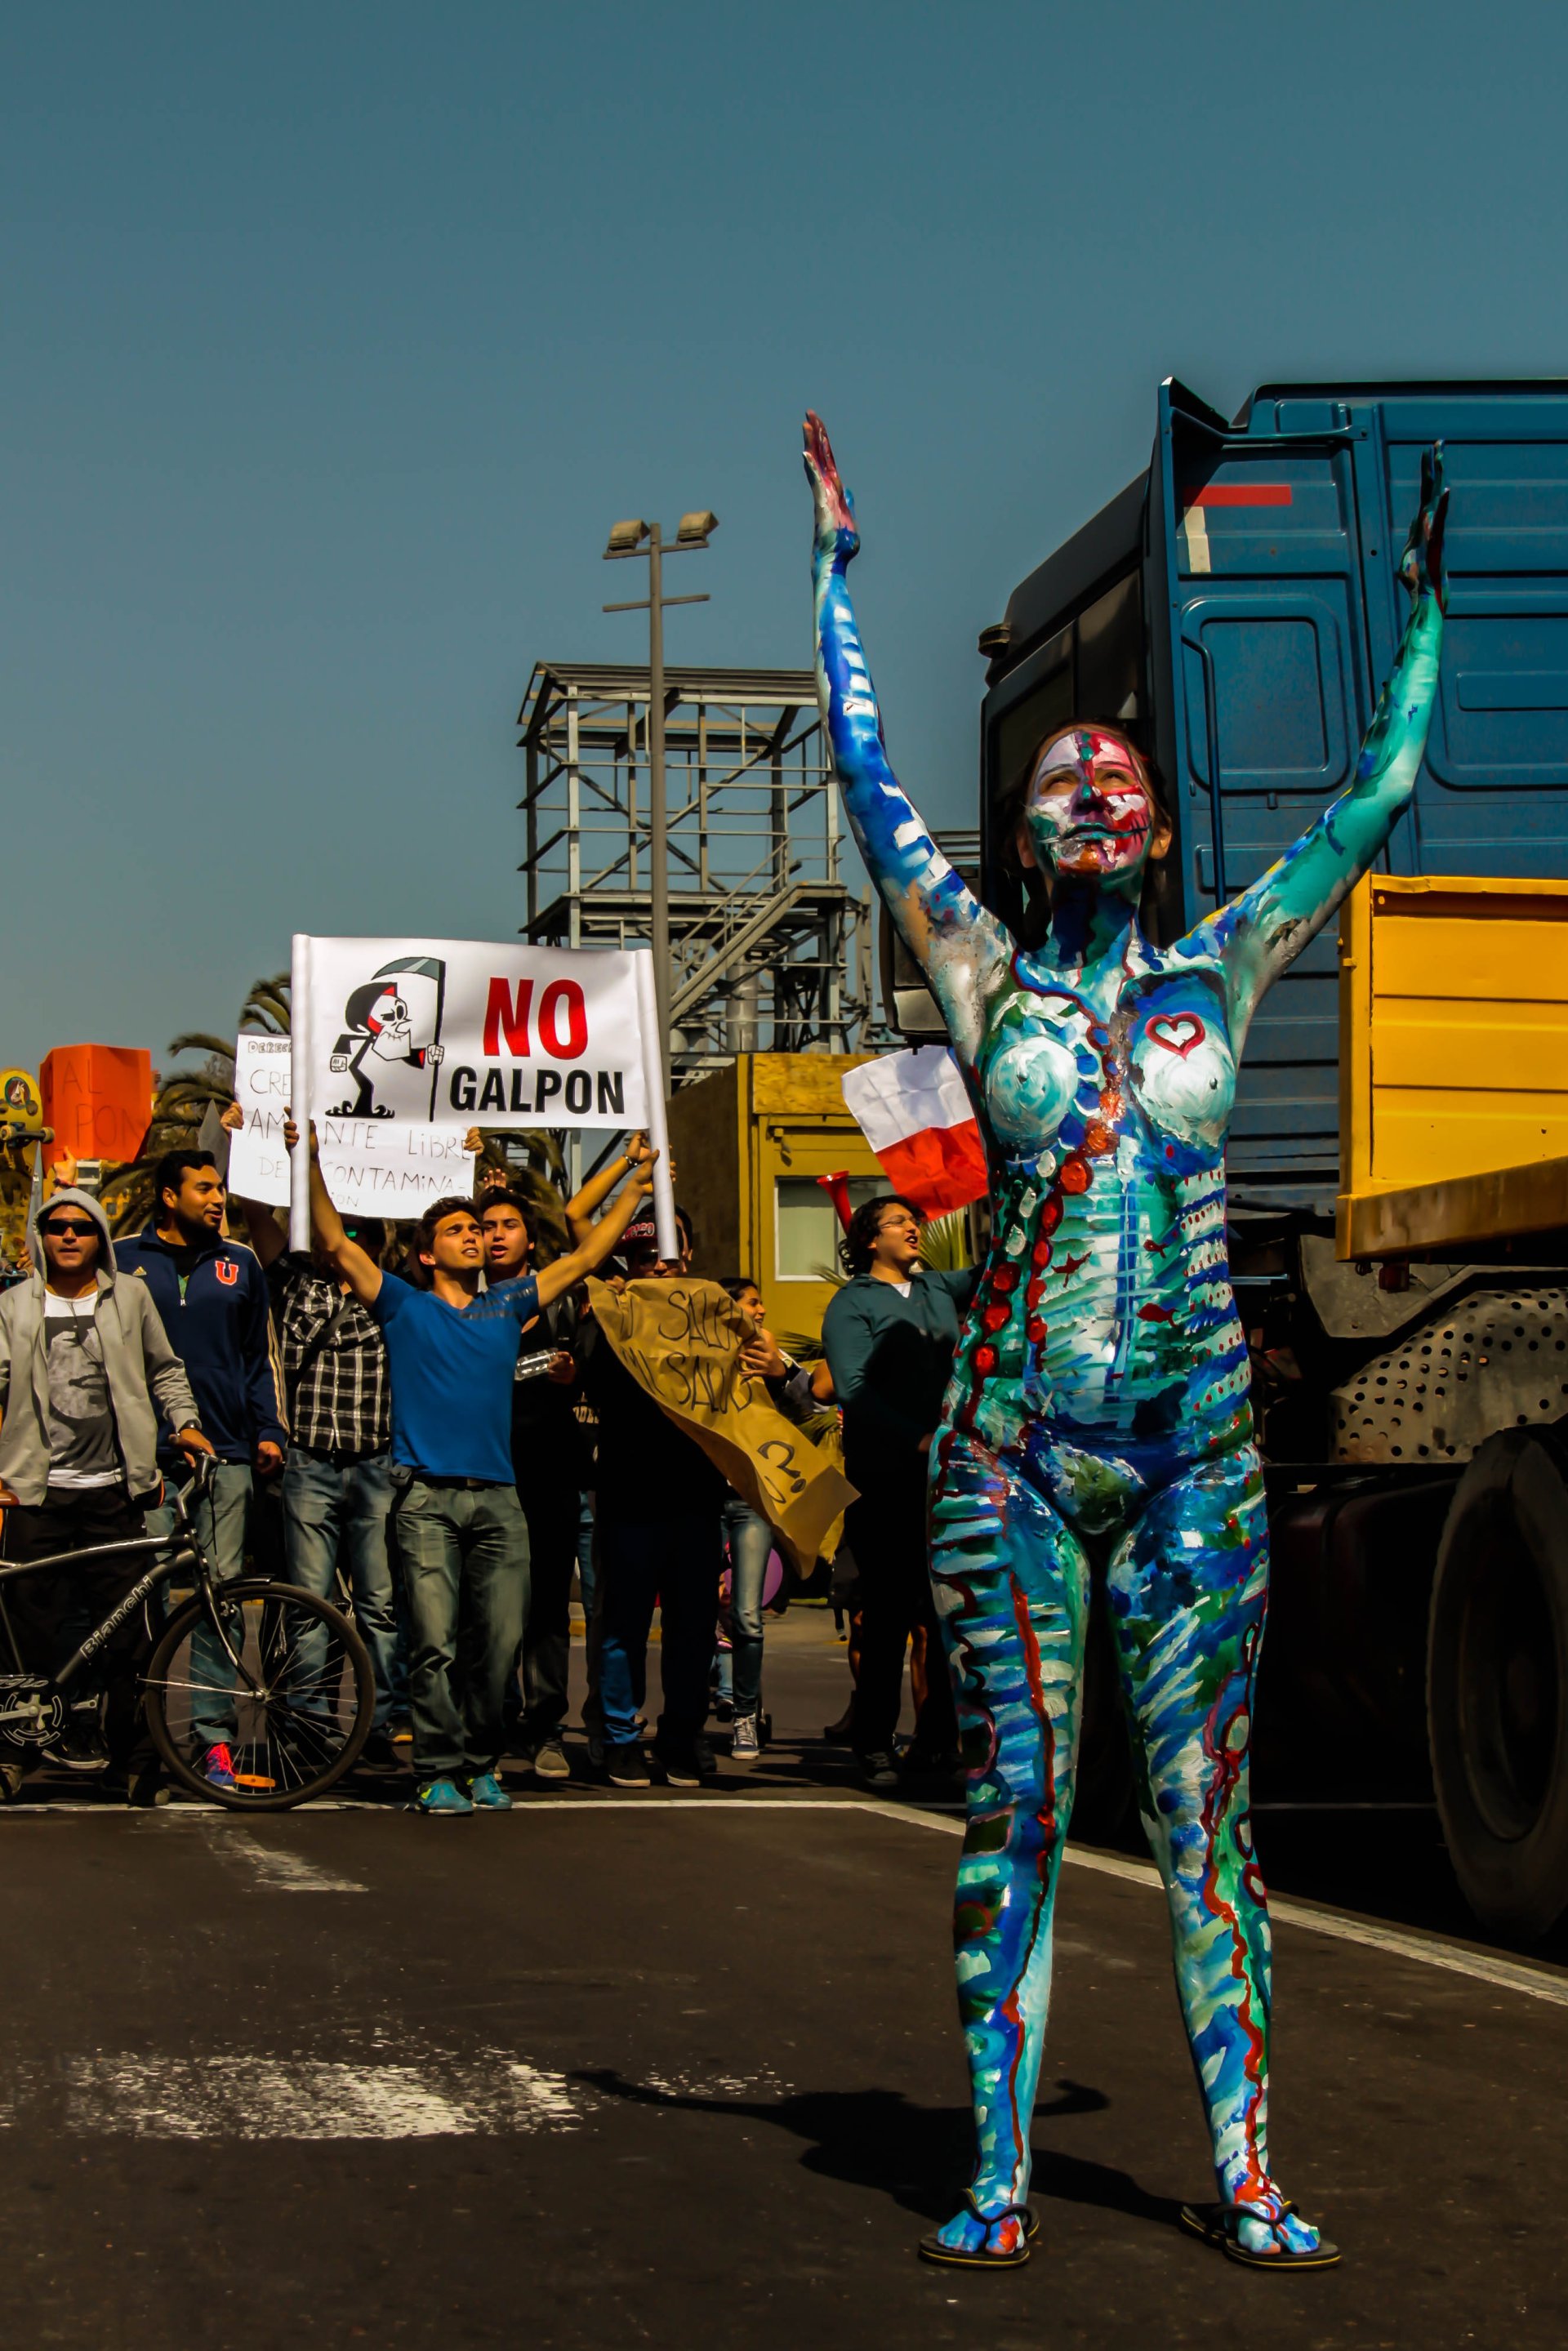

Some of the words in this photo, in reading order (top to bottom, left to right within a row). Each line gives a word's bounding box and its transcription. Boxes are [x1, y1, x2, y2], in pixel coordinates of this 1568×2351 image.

[483, 977, 588, 1060] NO
[449, 1066, 626, 1115] GALPON
[215, 1260, 239, 1287] U
[80, 1574, 154, 1660] Bianchi
